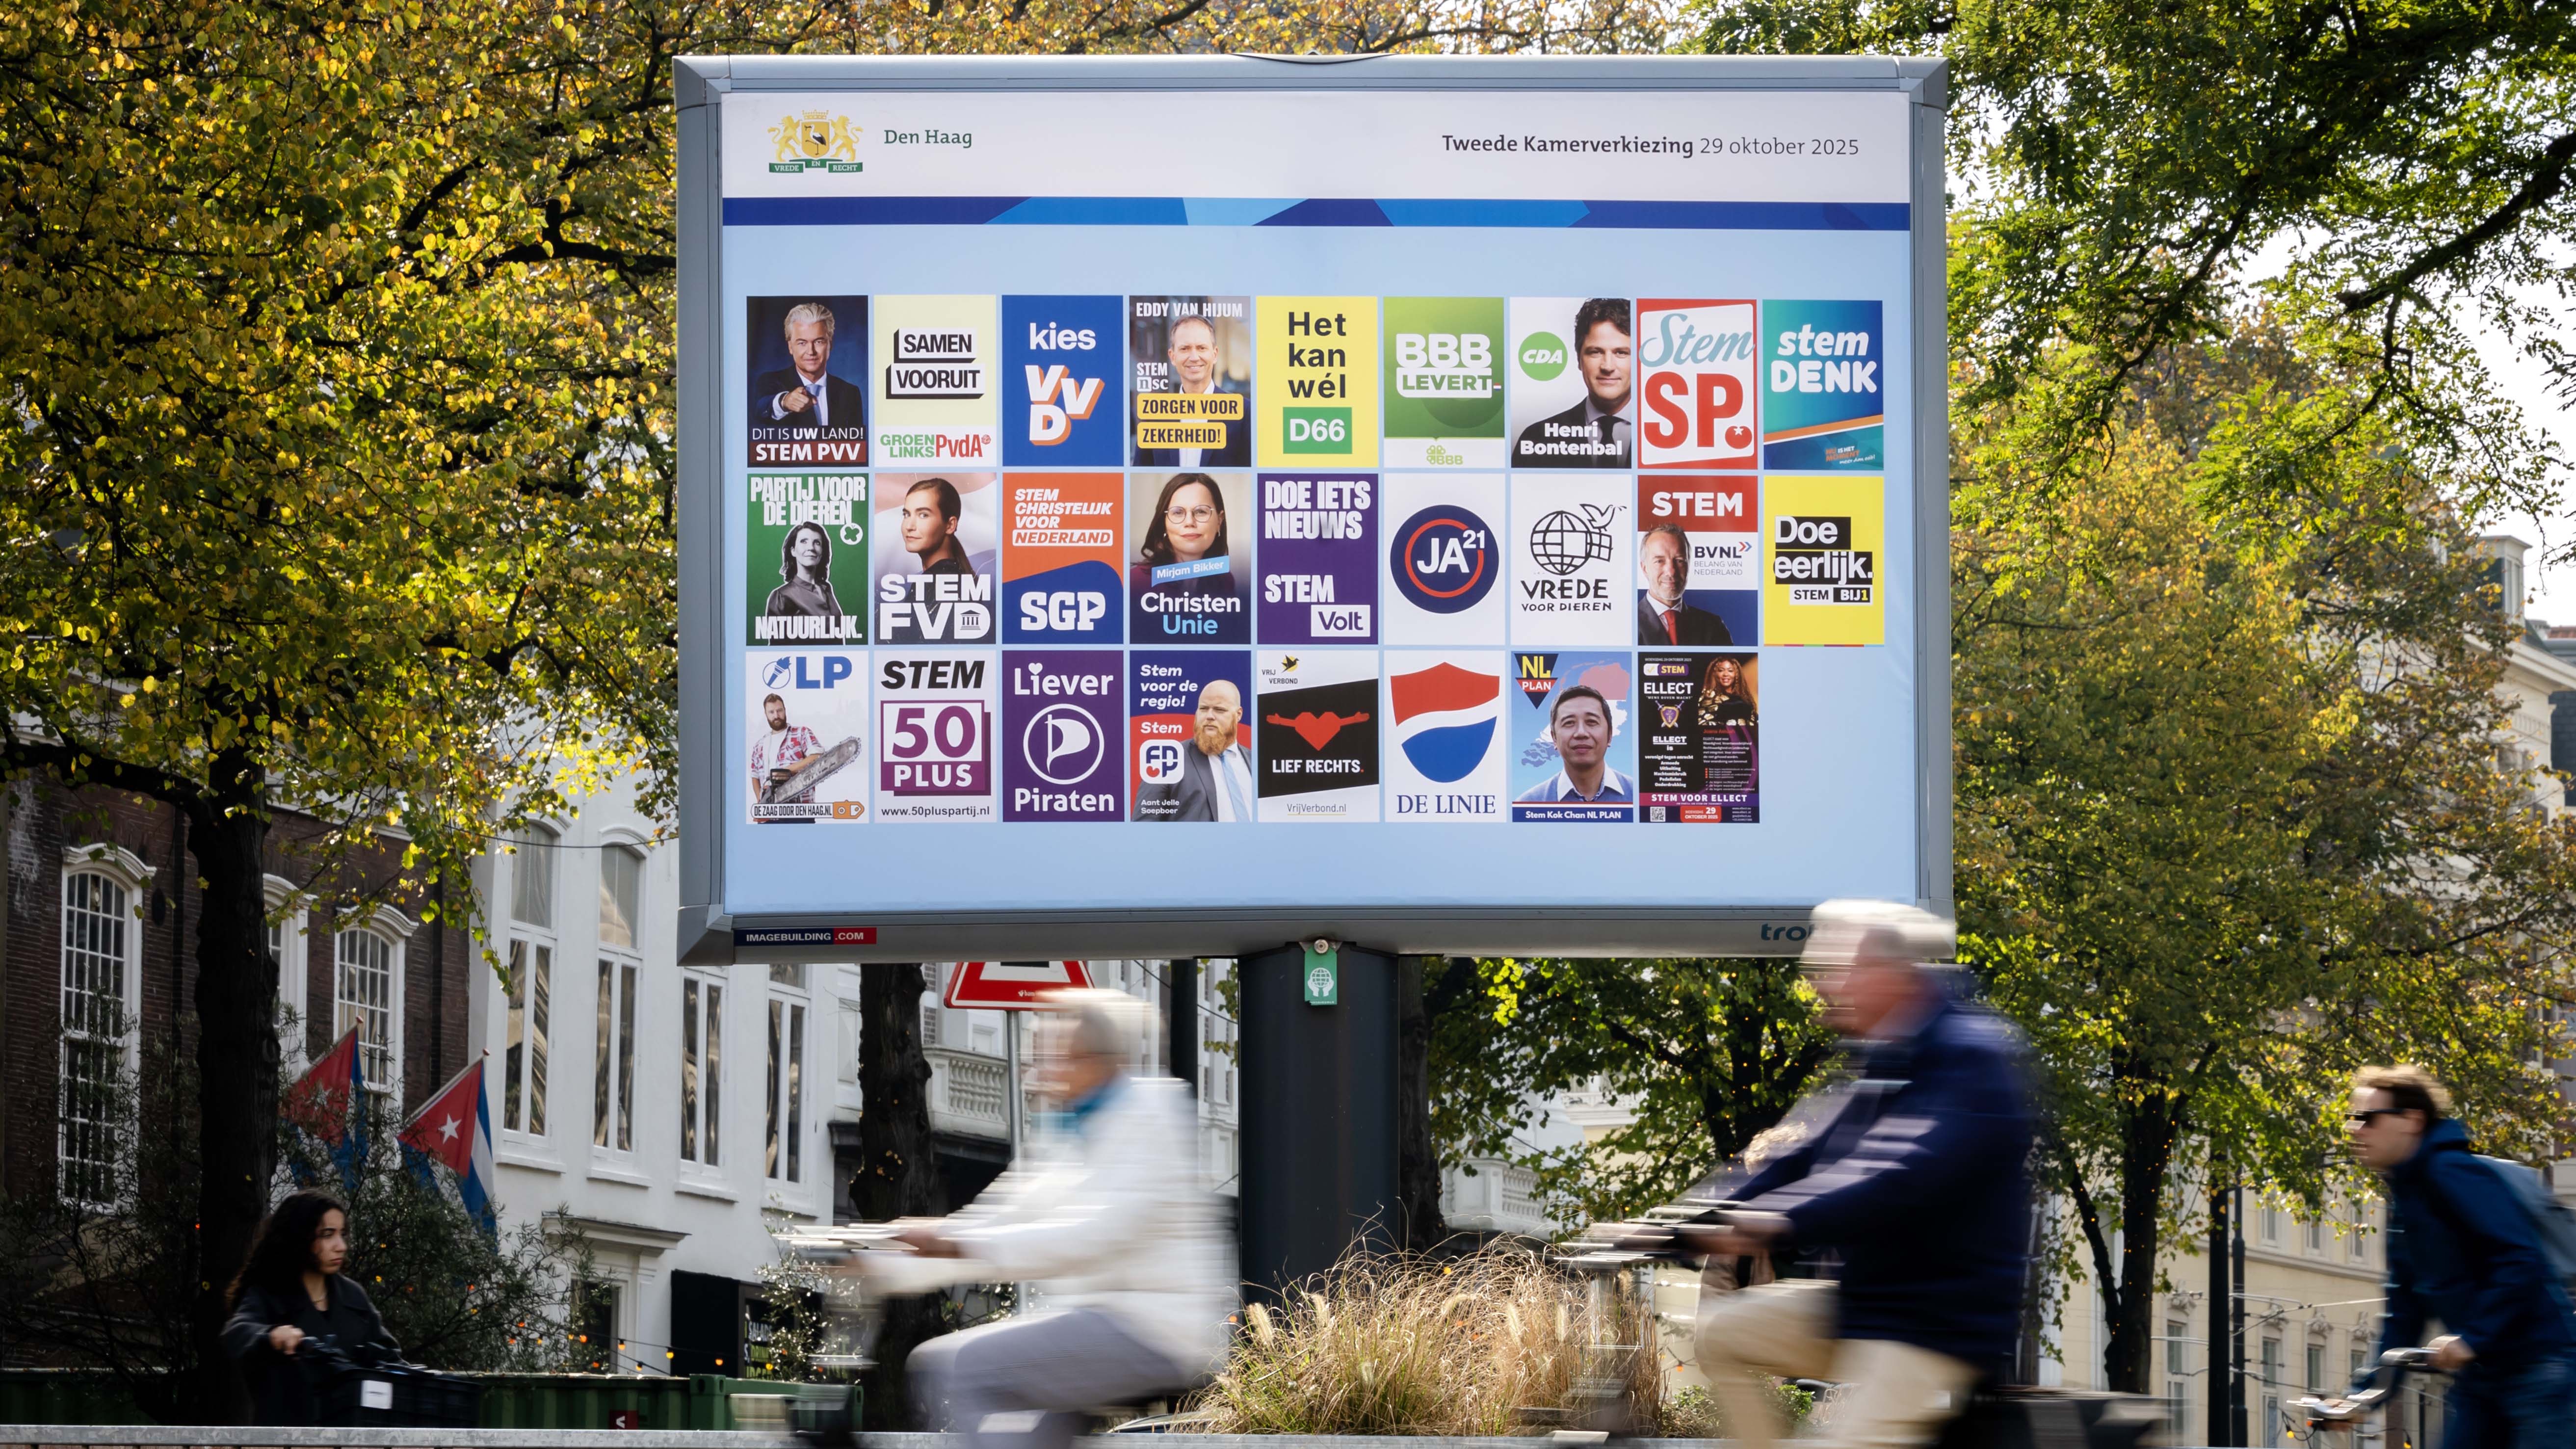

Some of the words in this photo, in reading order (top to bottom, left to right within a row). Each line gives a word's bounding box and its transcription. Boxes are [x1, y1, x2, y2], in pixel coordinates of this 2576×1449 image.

[884, 130, 919, 144] Den
[925, 130, 972, 148] Haag
[1443, 134, 1518, 152] Tweede
[1525, 135, 1694, 158] Kamerverkiezing
[1701, 138, 1723, 154] 29
[1730, 138, 1805, 155] oktober
[1812, 139, 1859, 155] 2025
[1136, 303, 1168, 316] EDDY
[1173, 303, 1198, 316] VAN
[1203, 303, 1242, 318] HIJUM
[1289, 312, 1346, 336] Het
[904, 334, 972, 352] SAMEN
[1030, 322, 1096, 350] kies
[1639, 314, 1756, 367] Stem
[1778, 324, 1868, 356] stem
[1289, 343, 1345, 367] kan
[1396, 334, 1492, 368] BBB
[1523, 349, 1562, 364] CDA
[1137, 362, 1167, 376] STEM
[1771, 360, 1876, 393] DENK
[896, 370, 980, 388] VOORUIT
[1288, 372, 1345, 398] wél
[1403, 375, 1492, 390] LEVERT
[1143, 400, 1195, 414] ZORGEN
[1200, 400, 1237, 414] VOOR
[753, 428, 774, 440] DIT
[778, 428, 789, 440] IS
[793, 428, 817, 439] UW
[822, 428, 863, 439] LAND!
[1143, 428, 1221, 443] ZEKERHEID!
[1289, 419, 1345, 442] D66
[1545, 422, 1598, 437] Henri
[756, 444, 812, 460] STEM
[818, 444, 860, 460] PVV
[880, 435, 935, 446] GROEN
[936, 435, 982, 457] PvdA
[890, 447, 934, 457] LINKS
[1521, 441, 1622, 455] Bontenbal
[751, 477, 814, 501] PARTIJ
[817, 477, 865, 501] VOOR
[1015, 489, 1059, 501] STEM
[1265, 481, 1311, 509] DOE
[1317, 481, 1371, 509] IETS
[764, 501, 786, 526] DE
[790, 501, 852, 526] DIEREN
[1015, 502, 1113, 515] CHRISTELIJK
[1652, 492, 1742, 516] STEM
[1016, 516, 1060, 528] VOOR
[1265, 511, 1362, 539] NIEUWS
[1775, 516, 1838, 544] Doe
[1015, 532, 1111, 544] NEDERLAND
[1694, 546, 1742, 558] BVNL
[1157, 567, 1190, 580] Mirjam
[1193, 561, 1224, 573] Bikker
[1774, 551, 1873, 585] eerlijk.
[880, 574, 990, 602] STEM
[1265, 574, 1334, 603] STEM
[1521, 579, 1608, 599] VREDE
[1794, 589, 1829, 600] STEM
[1840, 589, 1868, 601] BIJ1
[1021, 592, 1105, 631] SGP
[1141, 592, 1240, 612] Christen
[1560, 603, 1611, 611] DIEREN
[755, 616, 862, 639] NATUURLIJK.
[880, 603, 990, 639] FVD
[1163, 614, 1218, 634] Unie
[1318, 611, 1363, 631] Volt
[796, 657, 852, 689] LP
[881, 660, 985, 689] STEM
[1140, 665, 1182, 677] Stem
[1522, 656, 1551, 678] NL
[1015, 663, 1113, 695] Liever
[1140, 681, 1175, 691] voor
[1179, 679, 1198, 691] de
[1522, 681, 1551, 691] PLAN
[1644, 683, 1694, 694] ELLECT
[1140, 695, 1185, 710] regio!
[892, 706, 975, 758] 50
[1140, 722, 1182, 734] Stem
[894, 764, 972, 787] PLUS
[1272, 760, 1302, 773] LIEF
[1306, 760, 1364, 773] RECHTS.
[1015, 788, 1114, 812] Piraten
[1287, 804, 1346, 814] VrijVerbond.nl
[1397, 795, 1427, 814] DE
[1435, 795, 1496, 814] LINIE
[754, 806, 762, 816] DE
[763, 806, 778, 816] ZAAG
[779, 805, 795, 816] DOOR
[796, 805, 807, 816] DEN
[808, 805, 832, 816] HAAG.NL
[881, 806, 990, 817] www.50pluspartij.nl
[1525, 811, 1546, 819] Stem
[1564, 811, 1586, 819] Chan
